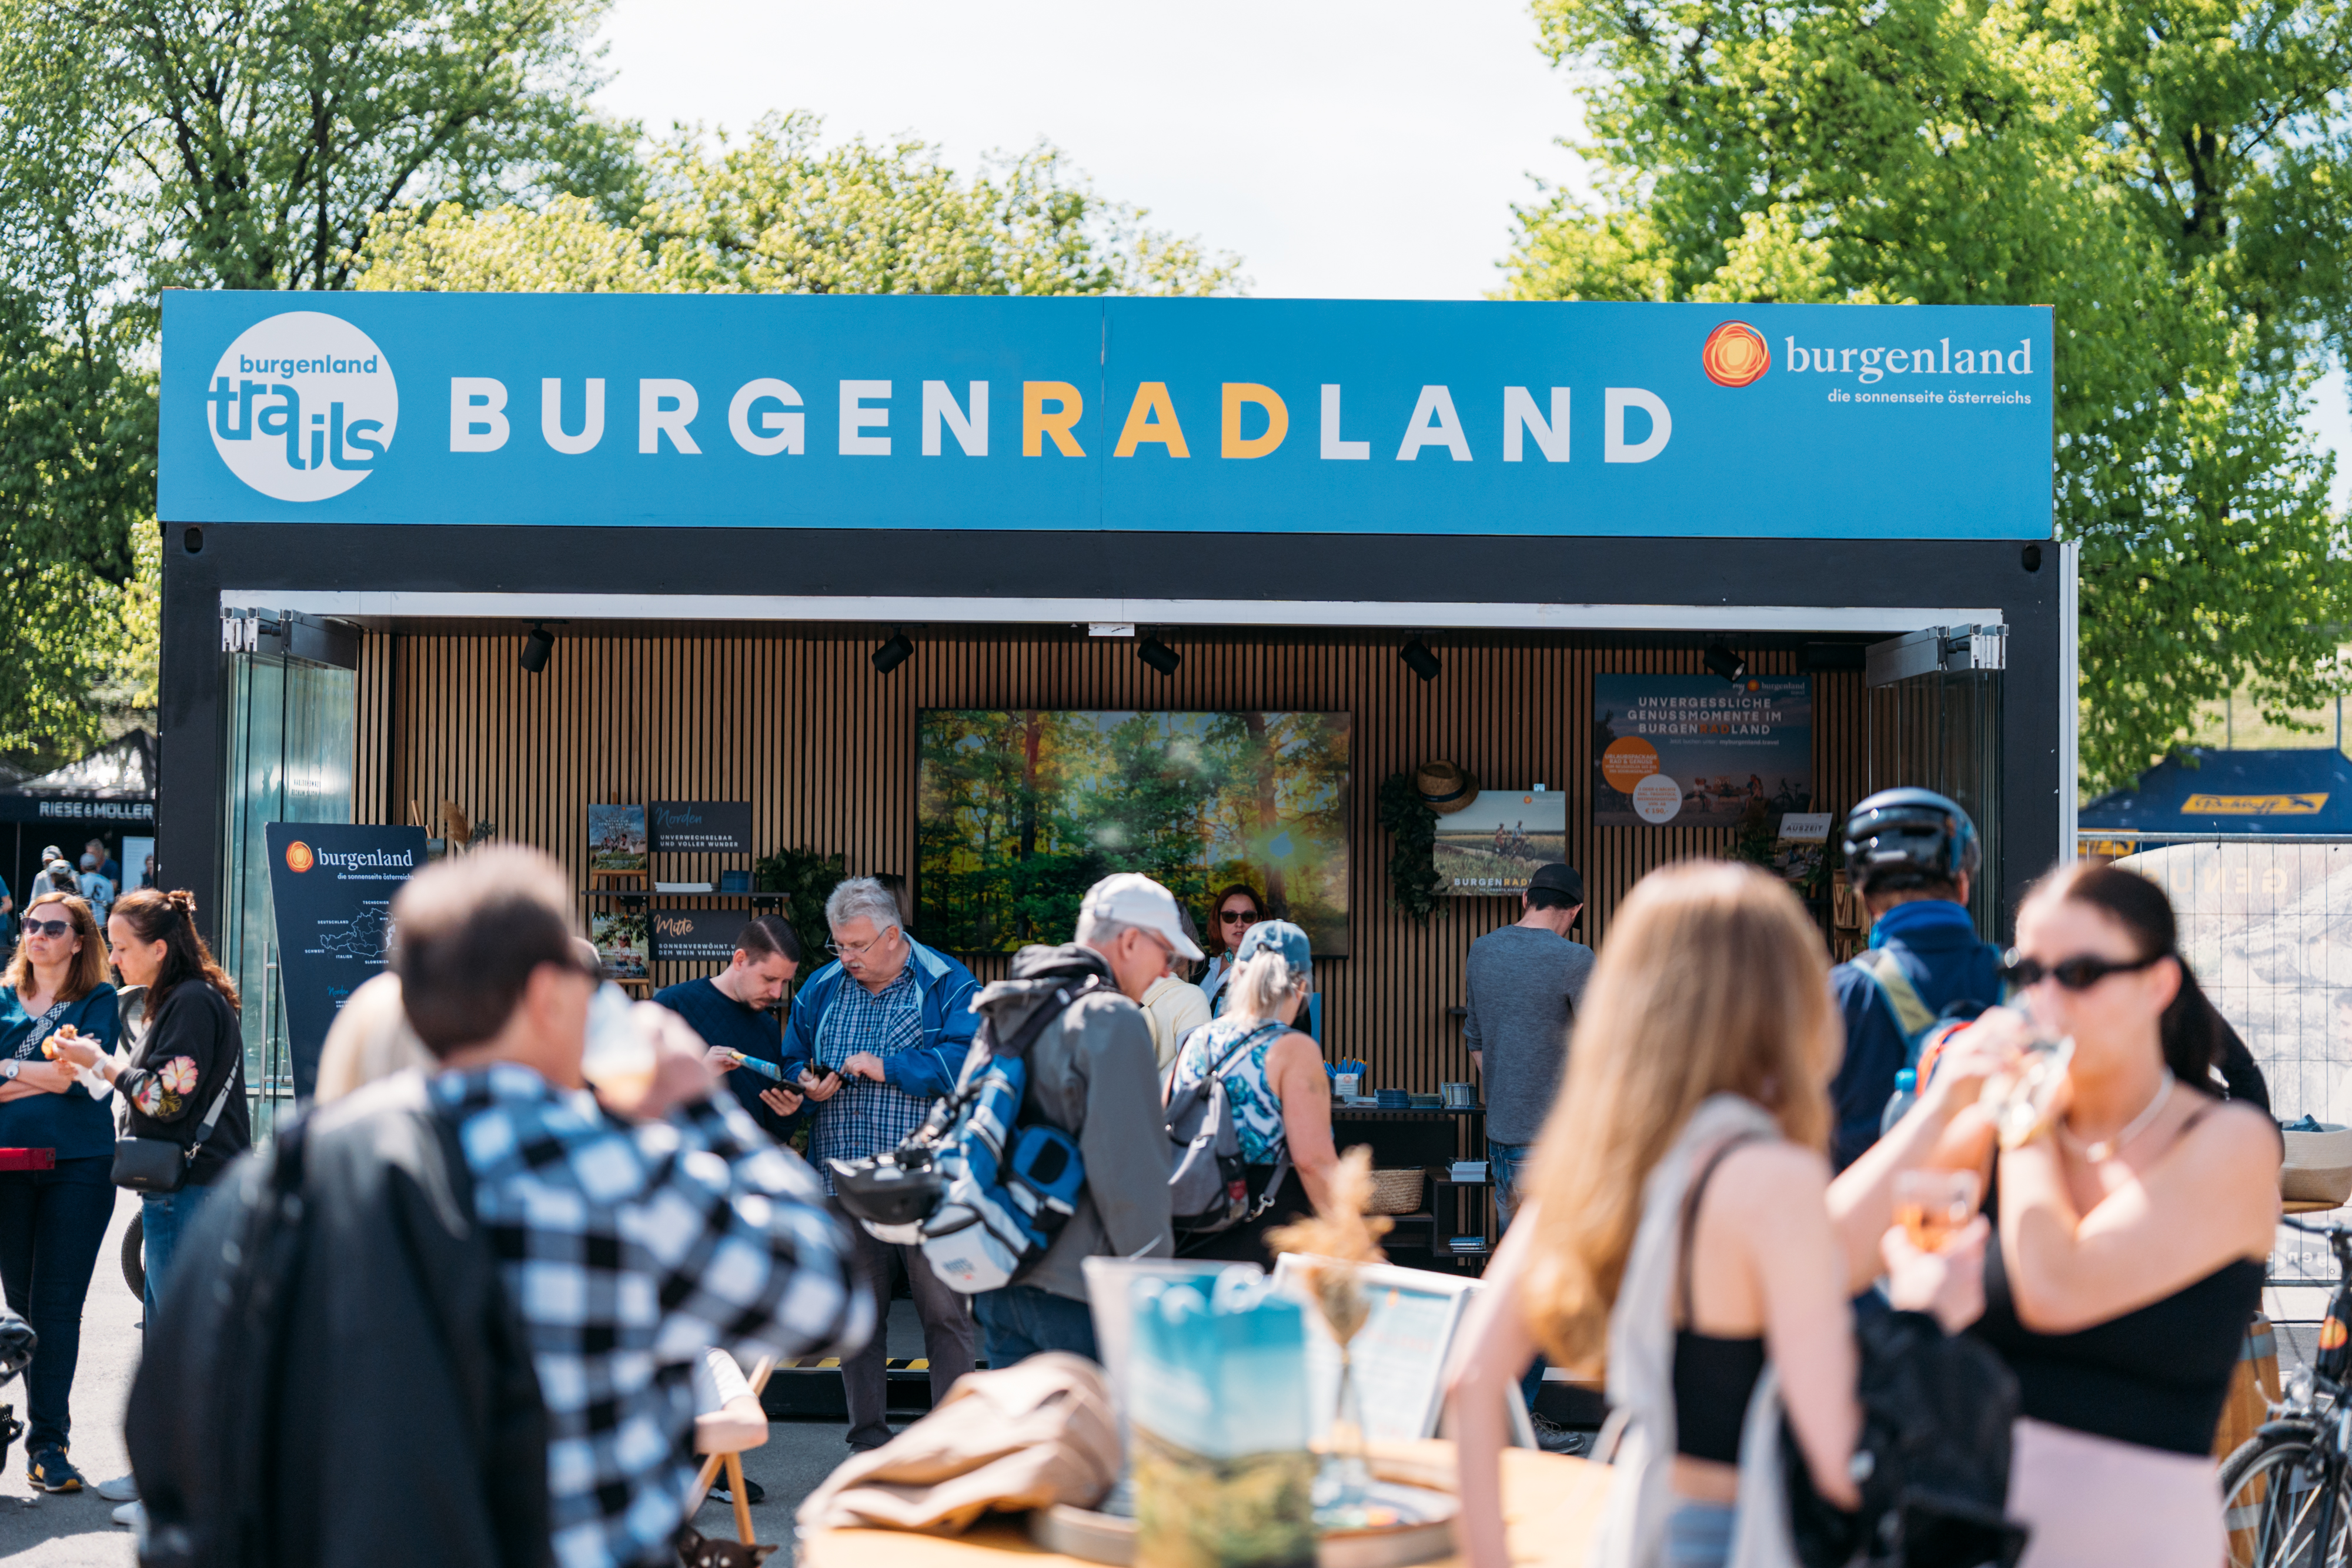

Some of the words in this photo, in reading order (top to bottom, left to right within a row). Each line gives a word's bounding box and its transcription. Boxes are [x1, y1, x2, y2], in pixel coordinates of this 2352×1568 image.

[239, 354, 378, 379] burgenland
[1784, 335, 2034, 384] burgenland
[1828, 388, 1851, 403] die
[1855, 389, 1944, 403] sonnenseite
[1947, 389, 2032, 404] österreichs
[207, 376, 386, 471] trails
[449, 376, 1674, 464] BURGENRADLAND
[1761, 681, 1805, 692] burgenland
[1638, 696, 1772, 709] UNVERGESSLICHE
[1627, 709, 1759, 721] GENUSSMOMENTE
[1766, 710, 1782, 721] IM
[1638, 723, 1770, 735] BURGENRADLAND
[39, 801, 83, 818] RIESE
[93, 802, 154, 820] MÜLLER
[655, 805, 702, 828] Norden
[317, 847, 413, 871] burgenland
[653, 914, 694, 938] Mitte
